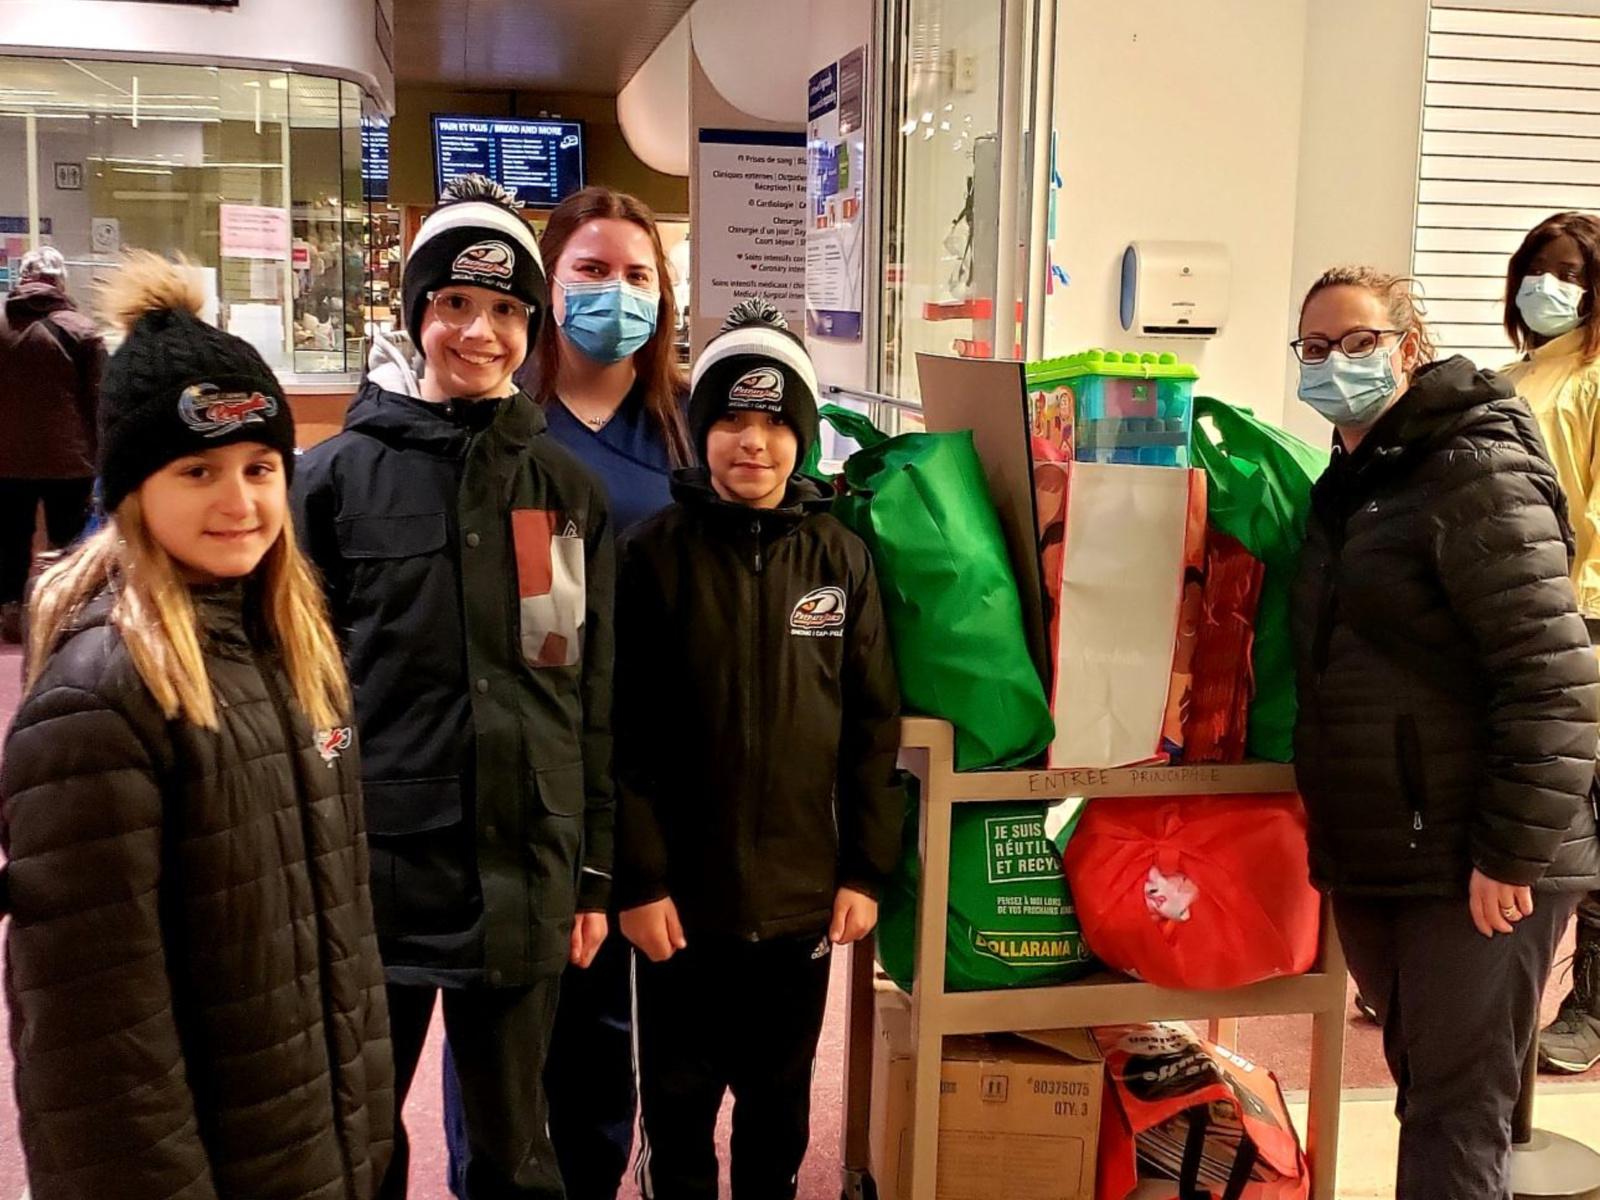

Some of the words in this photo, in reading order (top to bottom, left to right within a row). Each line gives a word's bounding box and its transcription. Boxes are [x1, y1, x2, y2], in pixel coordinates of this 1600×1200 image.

[469, 123, 488, 132] PLUS
[494, 125, 520, 134] BREAD
[520, 126, 538, 135] AND
[538, 127, 562, 136] MORE
[745, 155, 765, 163] Prises
[777, 157, 793, 166] sang
[713, 170, 743, 180] Cliniques
[756, 199, 794, 209] Cardiologie
[773, 217, 803, 226] Chirurgie
[728, 226, 758, 235] Chirurgie
[776, 228, 789, 236] jour
[755, 237, 773, 245] Court
[759, 264, 786, 273] Coronary
[712, 279, 729, 287] Soins
[730, 280, 756, 288] intensifs
[734, 290, 757, 298] Medical
[763, 291, 787, 300] Surgical
[994, 824, 1009, 840] JE
[1012, 822, 1042, 839] SUIS
[995, 840, 1051, 857] RÉUTIL
[996, 860, 1014, 875] ET
[997, 897, 1022, 906] PENSEZ
[1024, 895, 1029, 906] À
[1030, 897, 1043, 906] MOI
[1044, 898, 1061, 907] LORS
[997, 906, 1008, 915] DE
[1009, 906, 1022, 915] VOS
[1023, 906, 1059, 915] PROCHAINS
[1054, 1101, 1078, 1116] QTY.
[1081, 1101, 1088, 1116] 3
